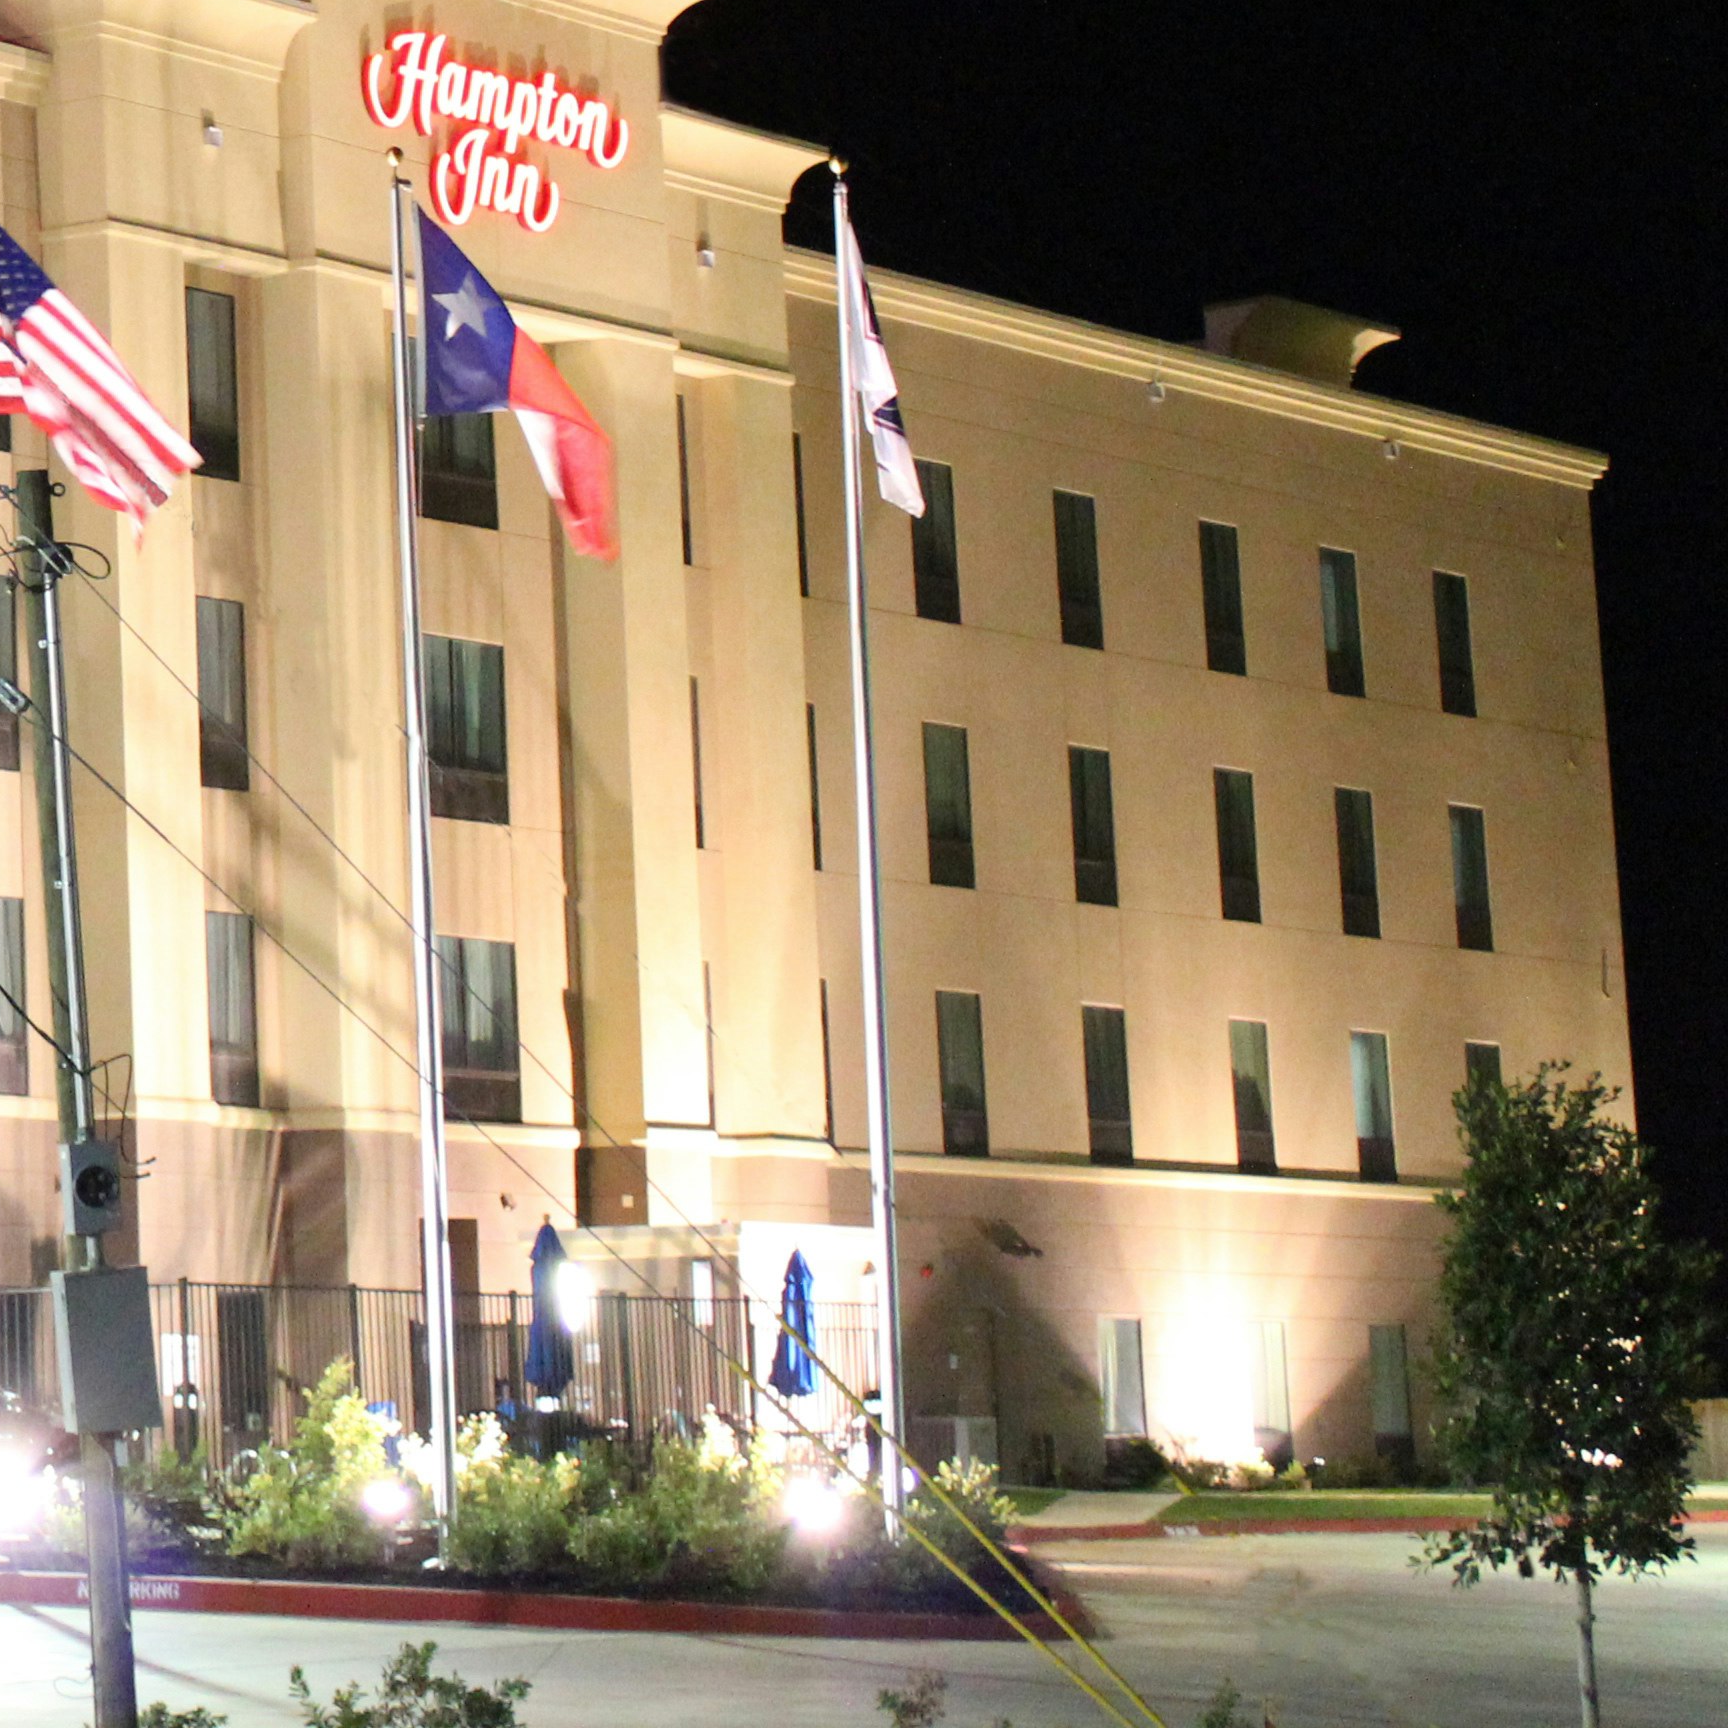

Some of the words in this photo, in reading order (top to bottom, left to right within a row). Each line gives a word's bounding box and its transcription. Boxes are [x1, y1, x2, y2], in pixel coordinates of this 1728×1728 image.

[362, 31, 629, 169] Hampton
[430, 128, 560, 233] Inn
[129, 1580, 180, 1600] RKING
